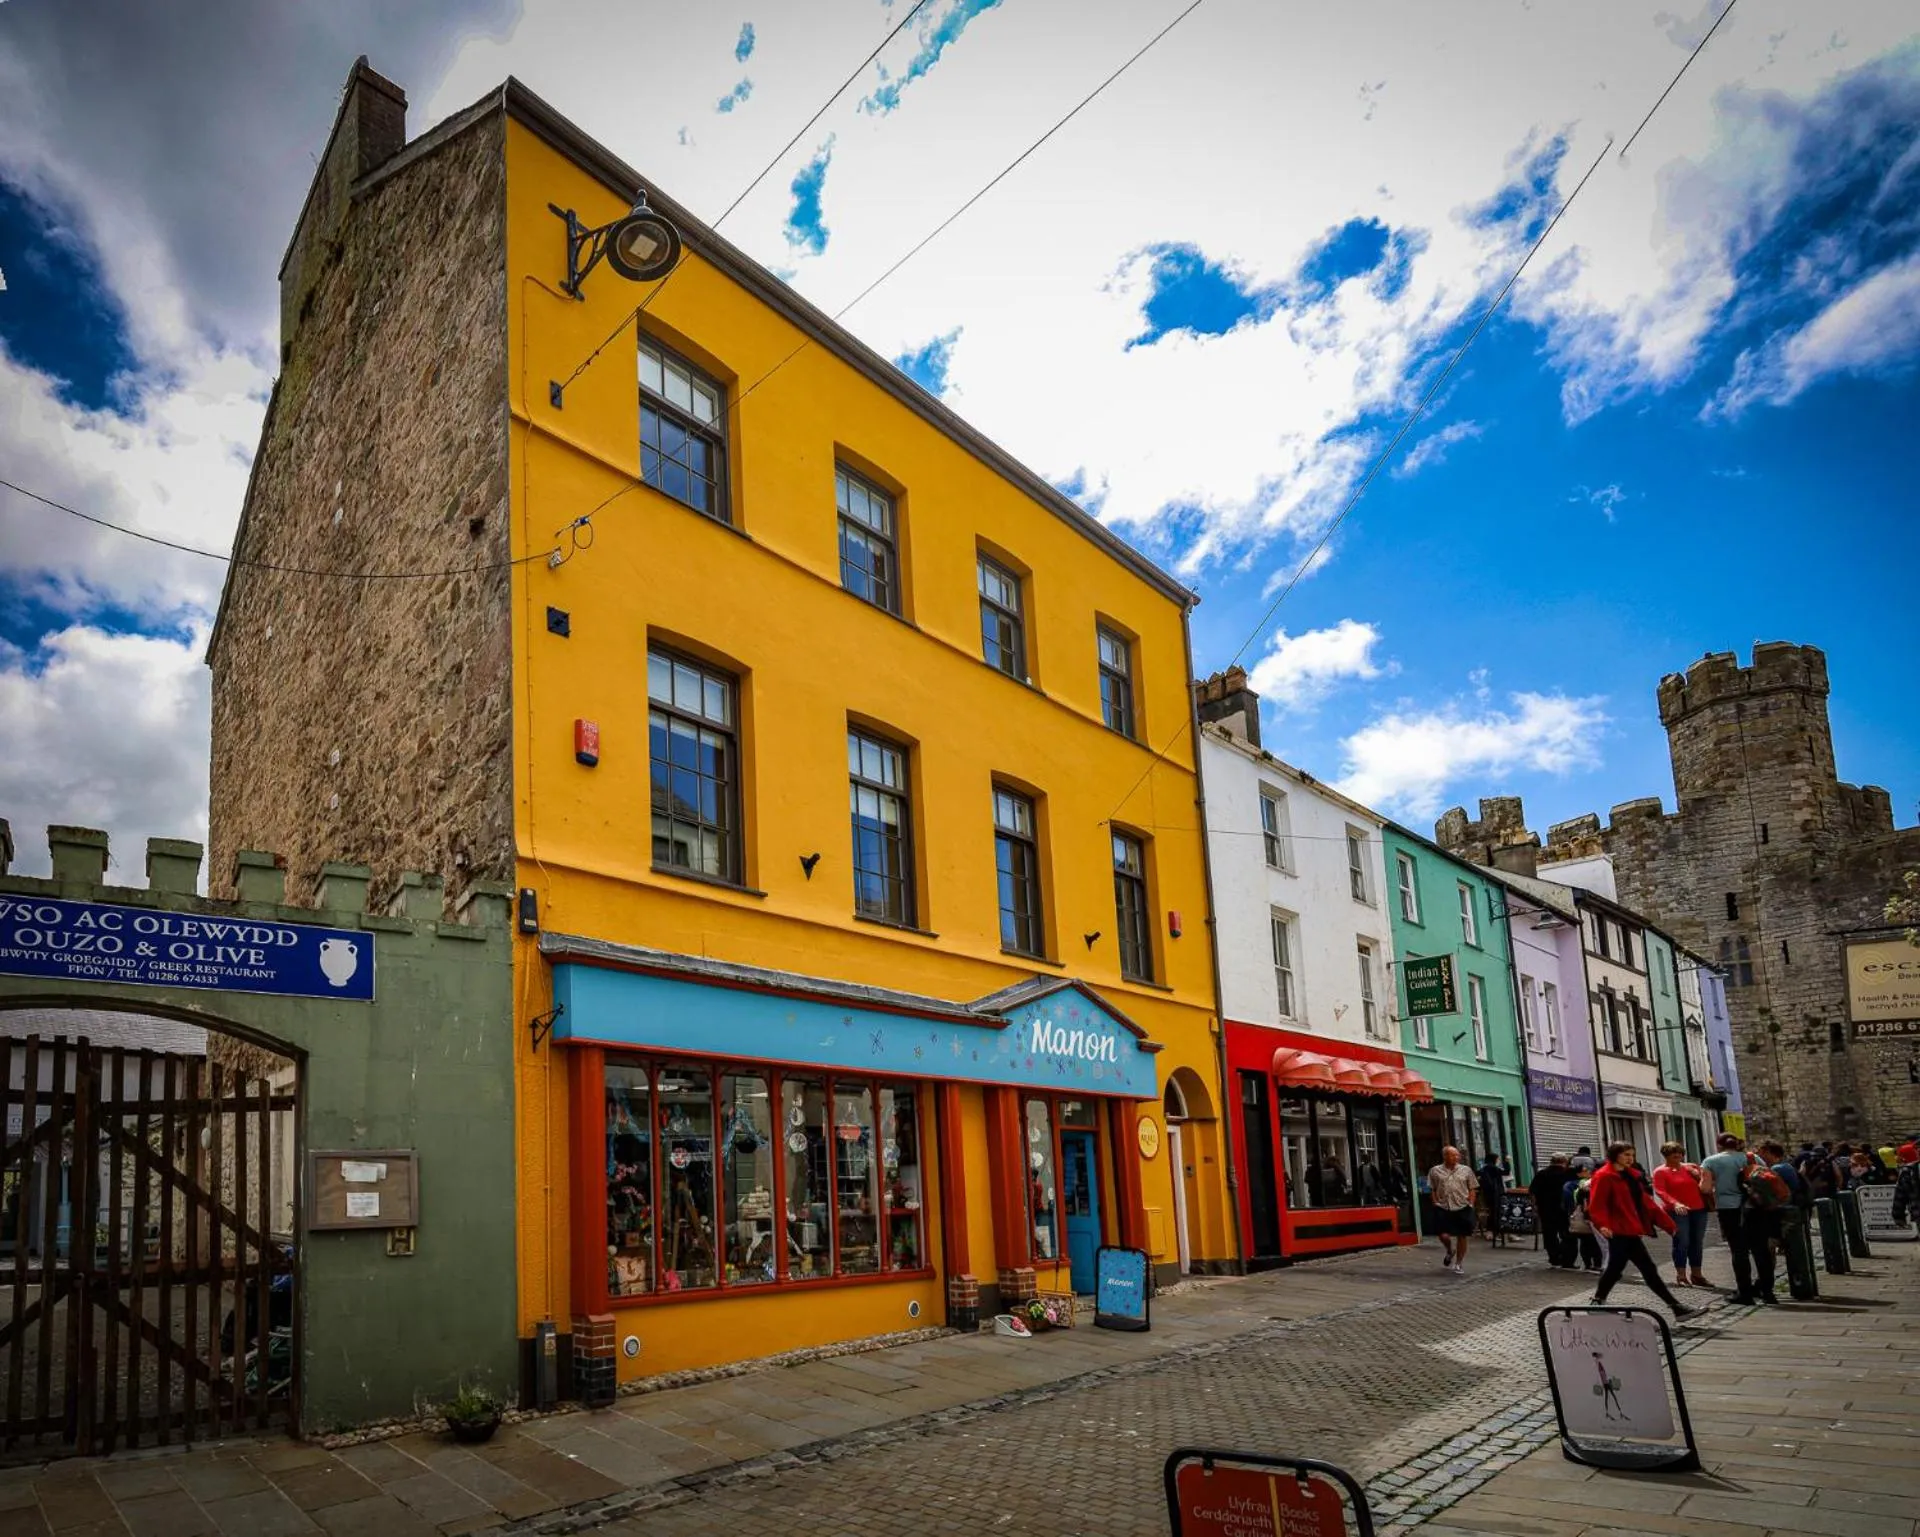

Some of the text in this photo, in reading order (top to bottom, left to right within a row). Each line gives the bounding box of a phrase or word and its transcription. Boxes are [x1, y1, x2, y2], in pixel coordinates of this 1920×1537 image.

[73, 911, 122, 930] AC
[133, 916, 298, 947] OLEWYDD
[14, 928, 266, 966] OUZO & OLIVE
[52, 952, 137, 968] GROEGAIDD
[149, 961, 192, 972] GREEK
[196, 964, 276, 979] RESTAURANT
[117, 968, 144, 979] TEL.
[148, 970, 180, 981] 01286
[1407, 967, 1439, 980] Indian
[1858, 994, 1889, 1002] Health
[1858, 1022, 1903, 1033] 01286
[1031, 1019, 1118, 1062] Manon
[1228, 1495, 1271, 1515] Llyfrau
[1280, 1502, 1320, 1521] Books
[1282, 1519, 1321, 1537] Music
